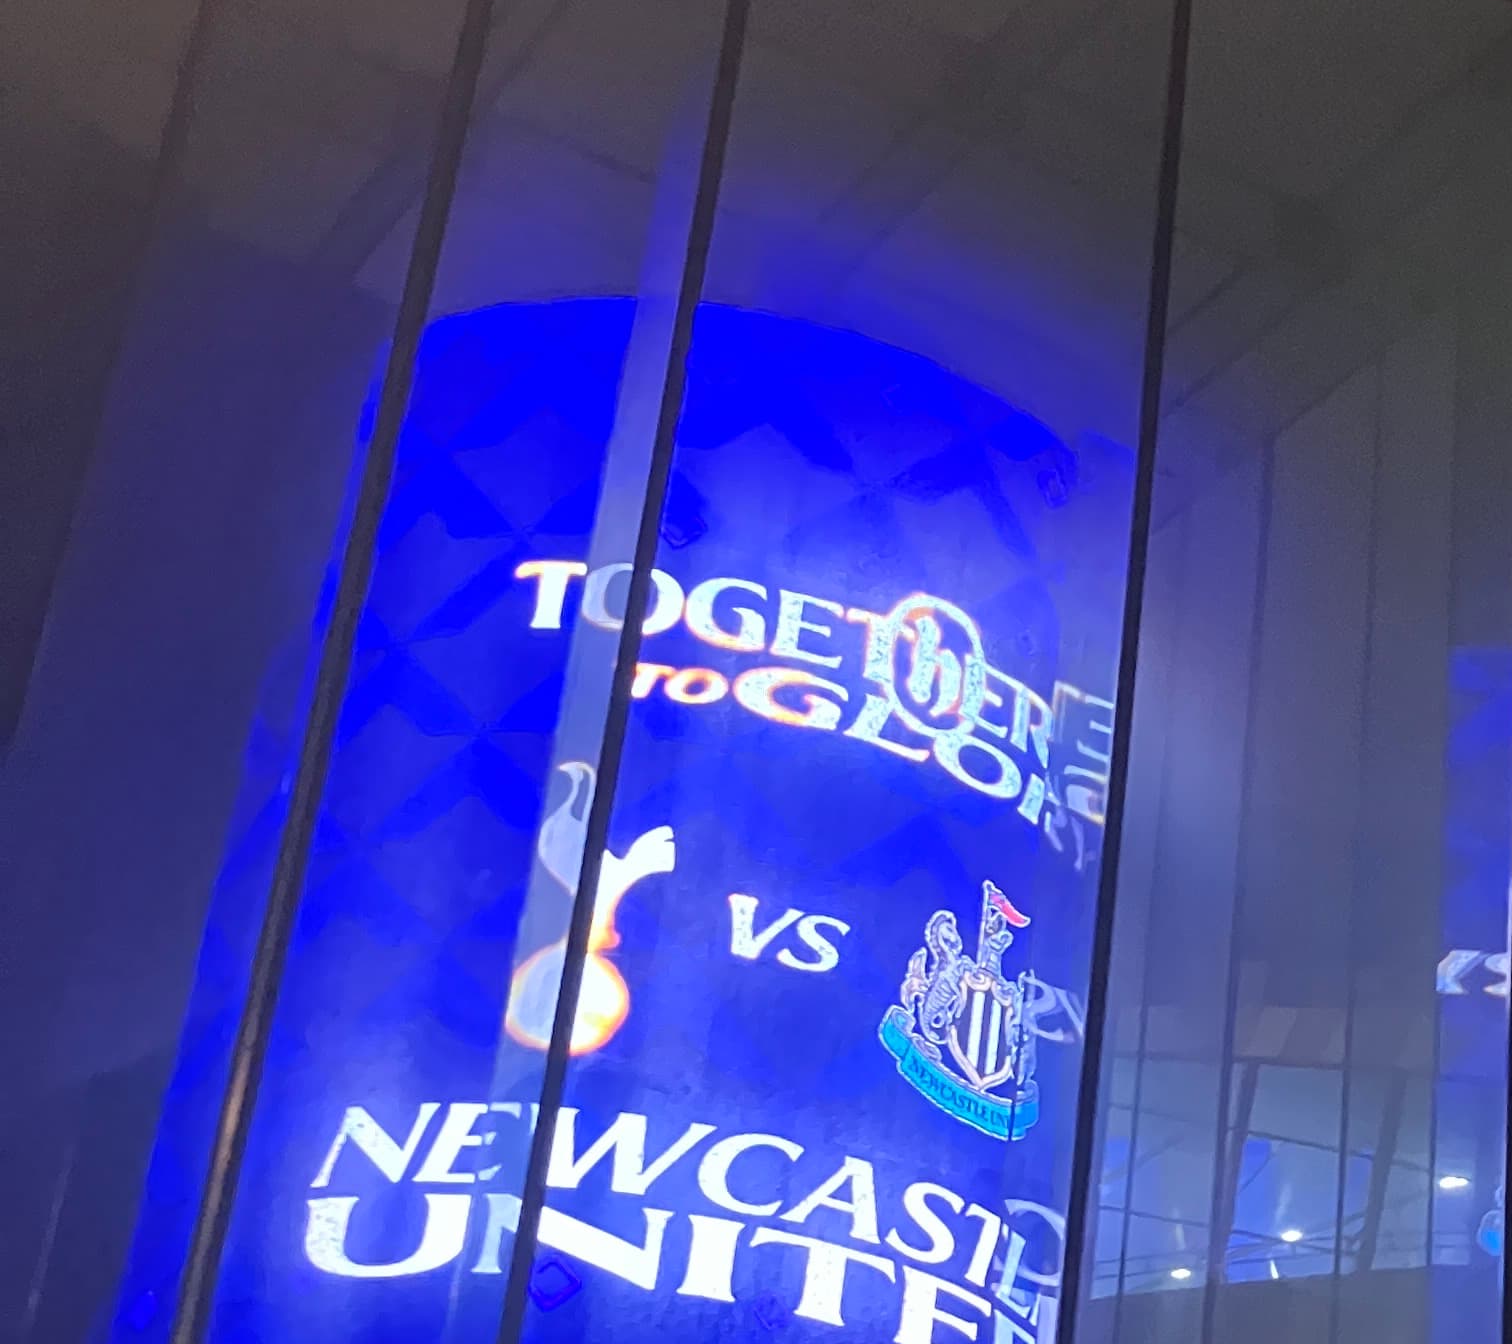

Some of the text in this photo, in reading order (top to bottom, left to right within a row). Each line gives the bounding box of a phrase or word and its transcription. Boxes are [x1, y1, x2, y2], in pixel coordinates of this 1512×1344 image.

[515, 560, 1053, 768] TOGETHER
[630, 662, 728, 705] TO
[729, 892, 850, 973] VS
[309, 1101, 1037, 1328] NEWCASTL
